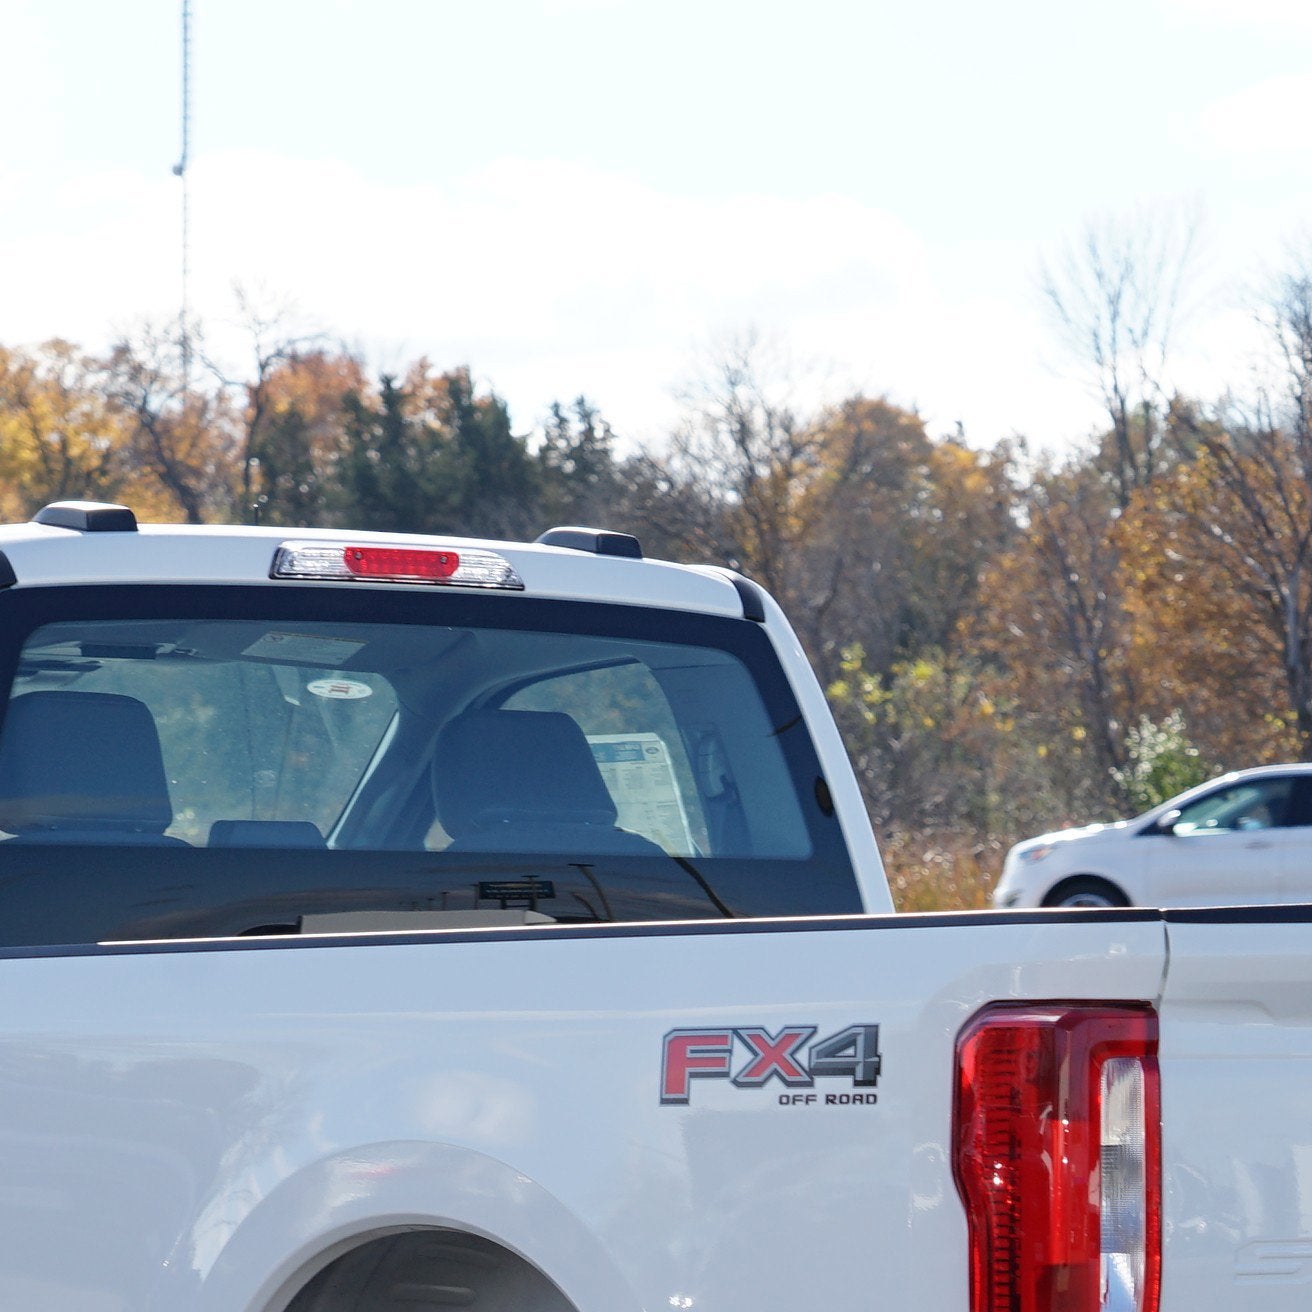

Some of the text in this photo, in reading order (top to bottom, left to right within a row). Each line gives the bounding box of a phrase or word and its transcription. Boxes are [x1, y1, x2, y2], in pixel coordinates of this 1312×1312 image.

[659, 1023, 882, 1107] FX4
[778, 1093, 878, 1106] OFF ROAD
